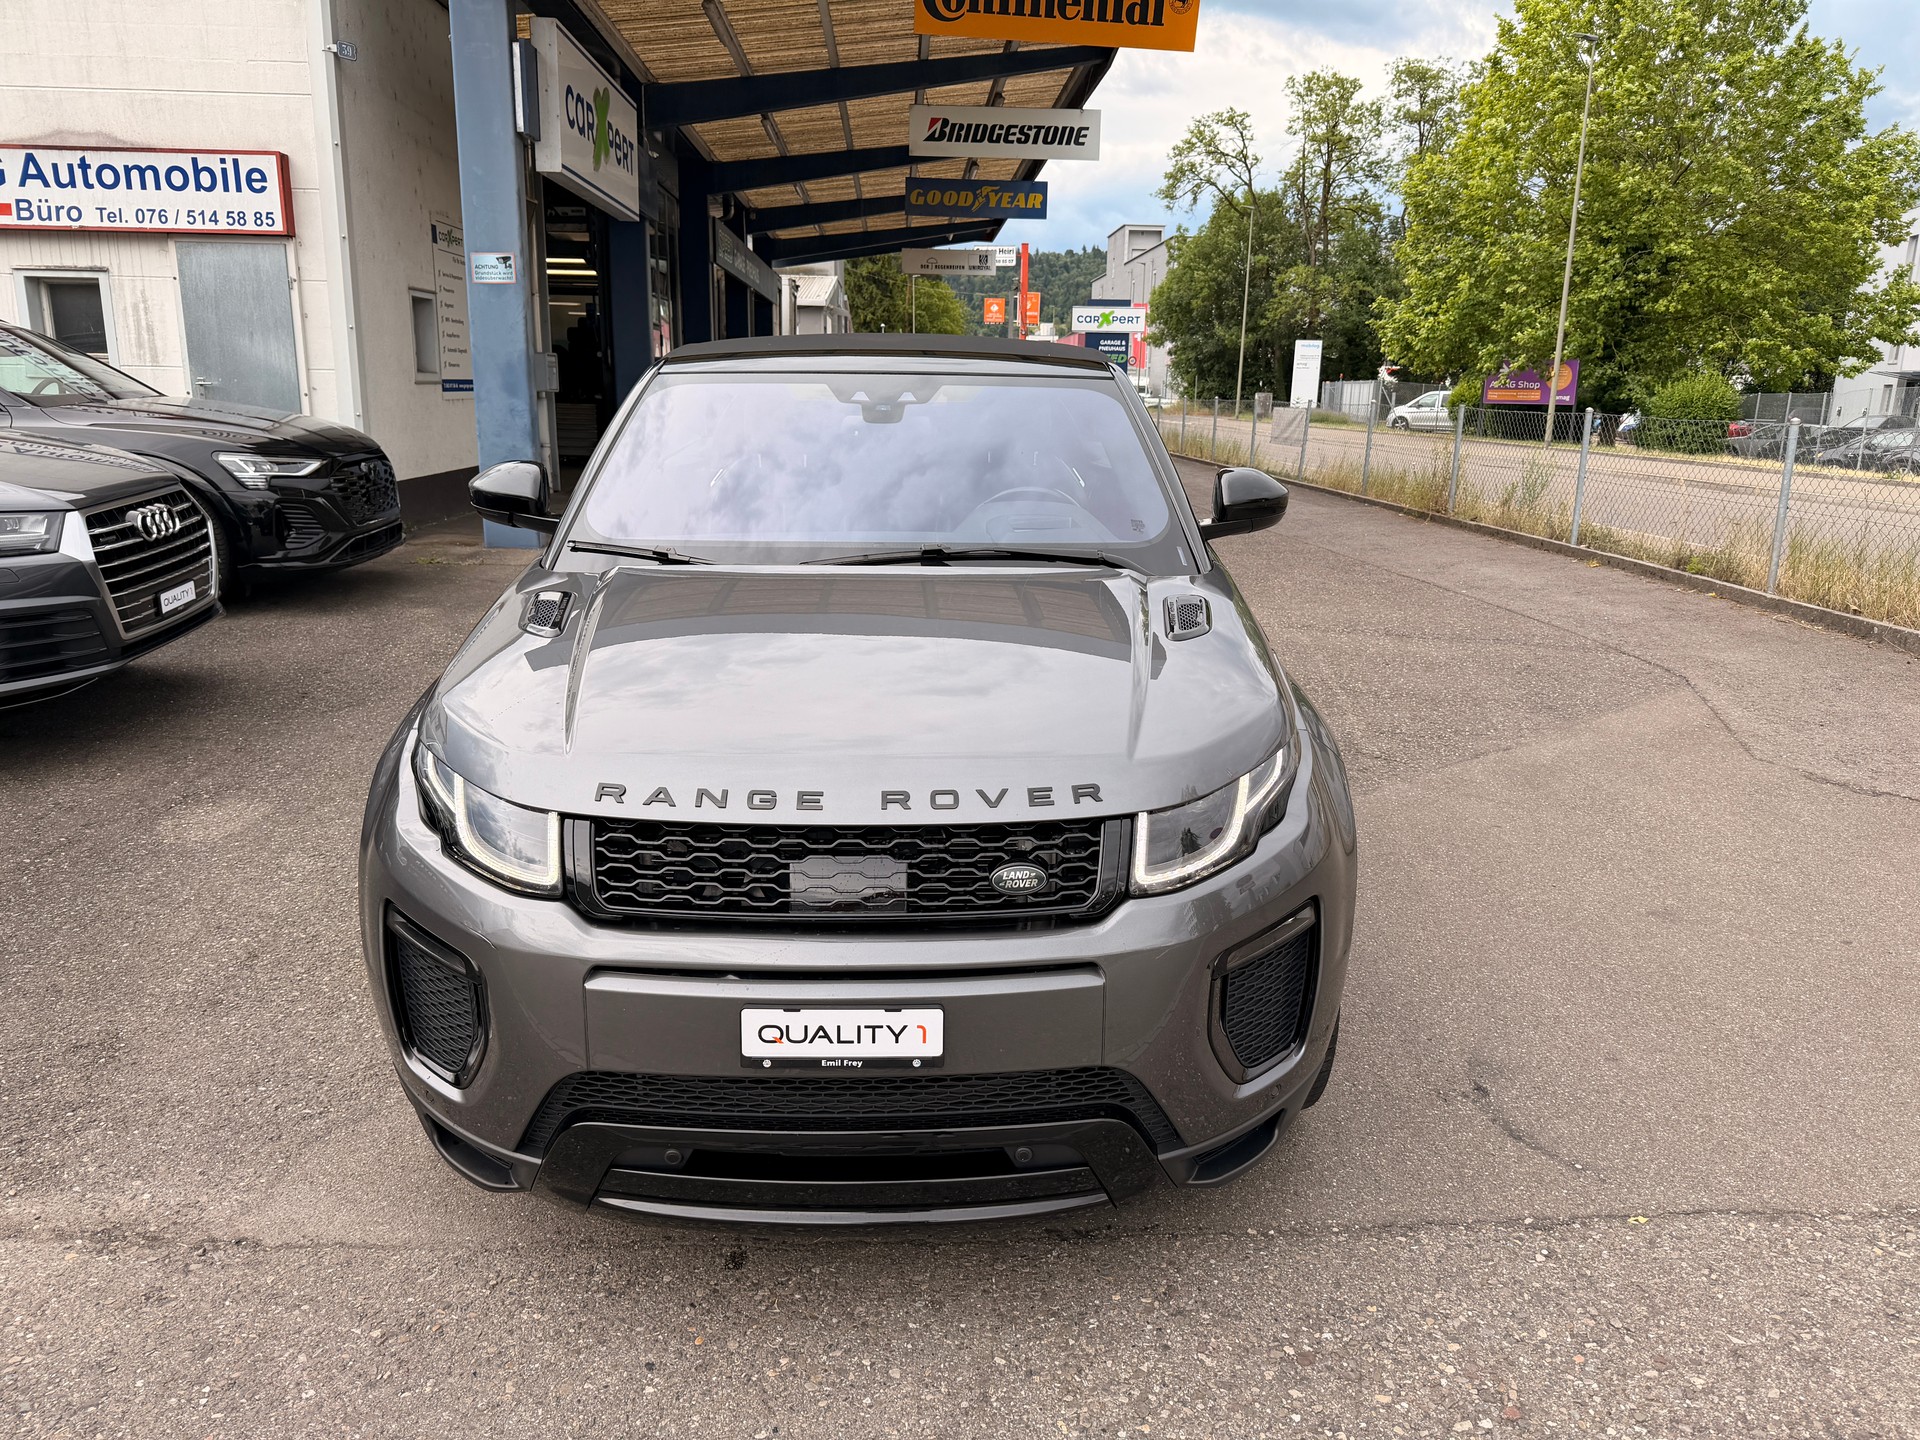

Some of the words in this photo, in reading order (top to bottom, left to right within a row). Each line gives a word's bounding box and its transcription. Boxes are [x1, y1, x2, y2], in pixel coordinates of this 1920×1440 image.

[923, 117, 1090, 146] BRIDGESTONE
[18, 152, 268, 194] Automobile
[15, 198, 83, 222] Büro
[95, 207, 128, 223] Tel.
[135, 208, 169, 224] 076
[174, 208, 180, 225] /
[186, 209, 219, 226] 514
[226, 210, 247, 227] 58
[254, 211, 275, 228] 85
[1517, 380, 1540, 390] Shop
[163, 589, 190, 607] QUALITY
[594, 782, 824, 810] RANGE
[881, 783, 1104, 810] ROVER
[1002, 870, 1030, 880] LAND
[1004, 879, 1039, 888] ROVER
[757, 1024, 908, 1044] QUALITY
[821, 1059, 841, 1067] Emil
[843, 1059, 863, 1069] Frey
